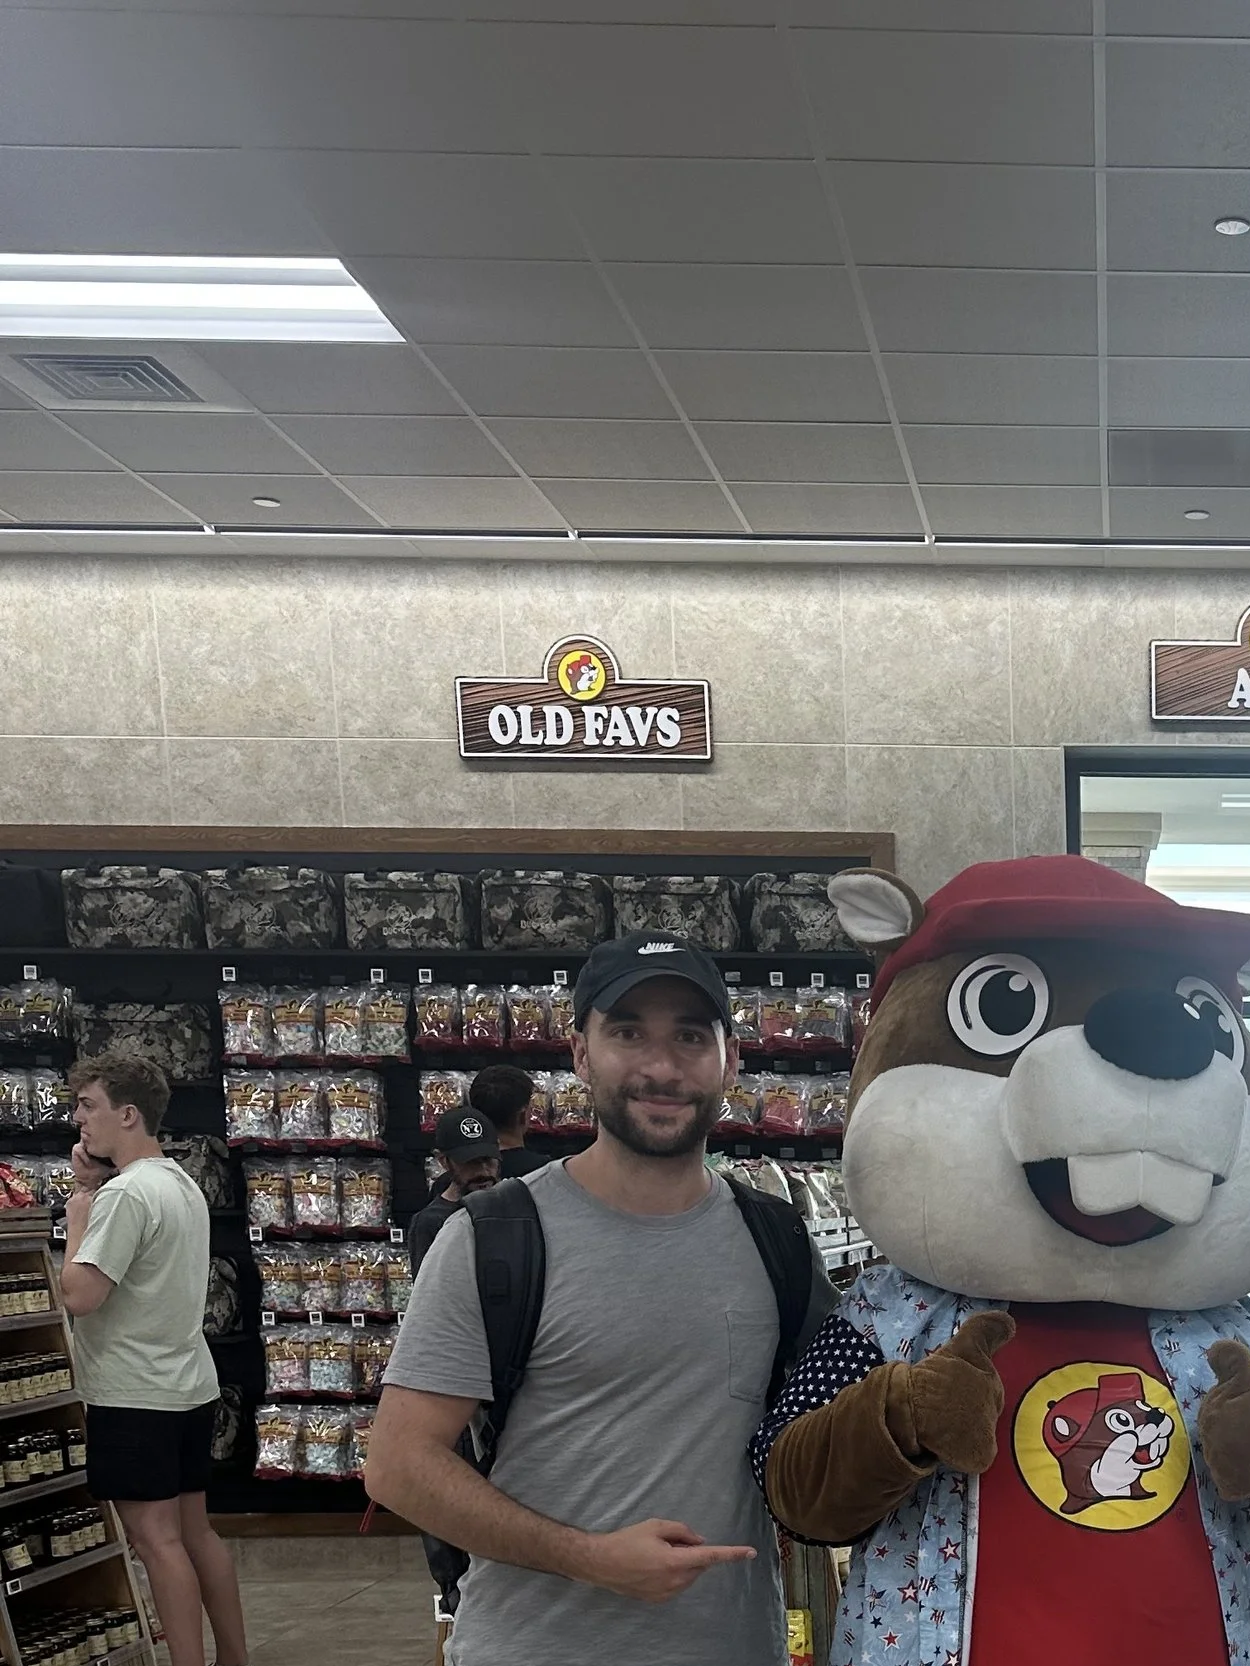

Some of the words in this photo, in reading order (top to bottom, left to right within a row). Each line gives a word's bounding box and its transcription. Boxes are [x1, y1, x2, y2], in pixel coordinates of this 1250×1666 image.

[487, 704, 575, 748] OLD
[582, 704, 682, 748] FAVS
[645, 942, 675, 951] NIKE
